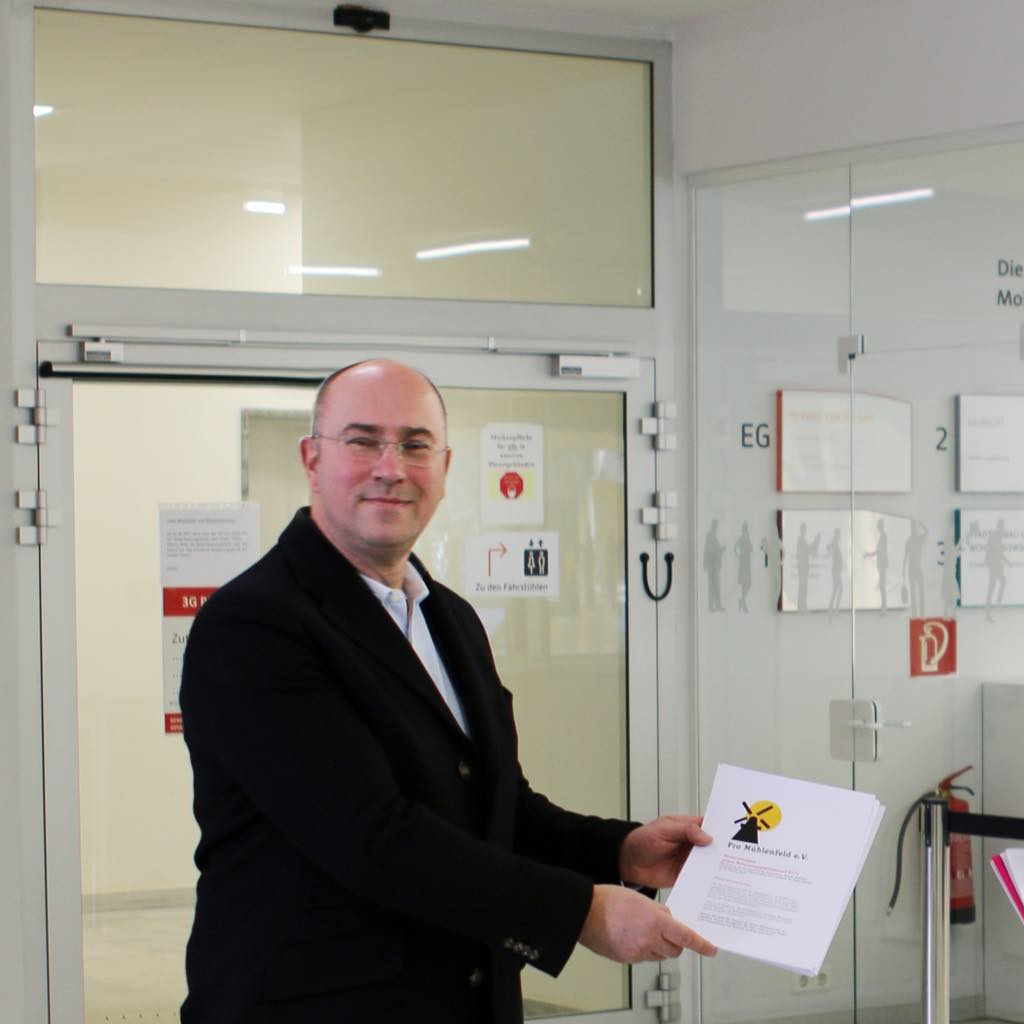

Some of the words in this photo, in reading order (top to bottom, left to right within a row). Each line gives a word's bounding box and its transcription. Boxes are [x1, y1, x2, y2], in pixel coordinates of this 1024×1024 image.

[997, 259, 1024, 277] Die
[741, 423, 771, 449] EG
[935, 426, 948, 451] 2
[182, 596, 197, 608] 3G
[727, 841, 742, 850] Pro
